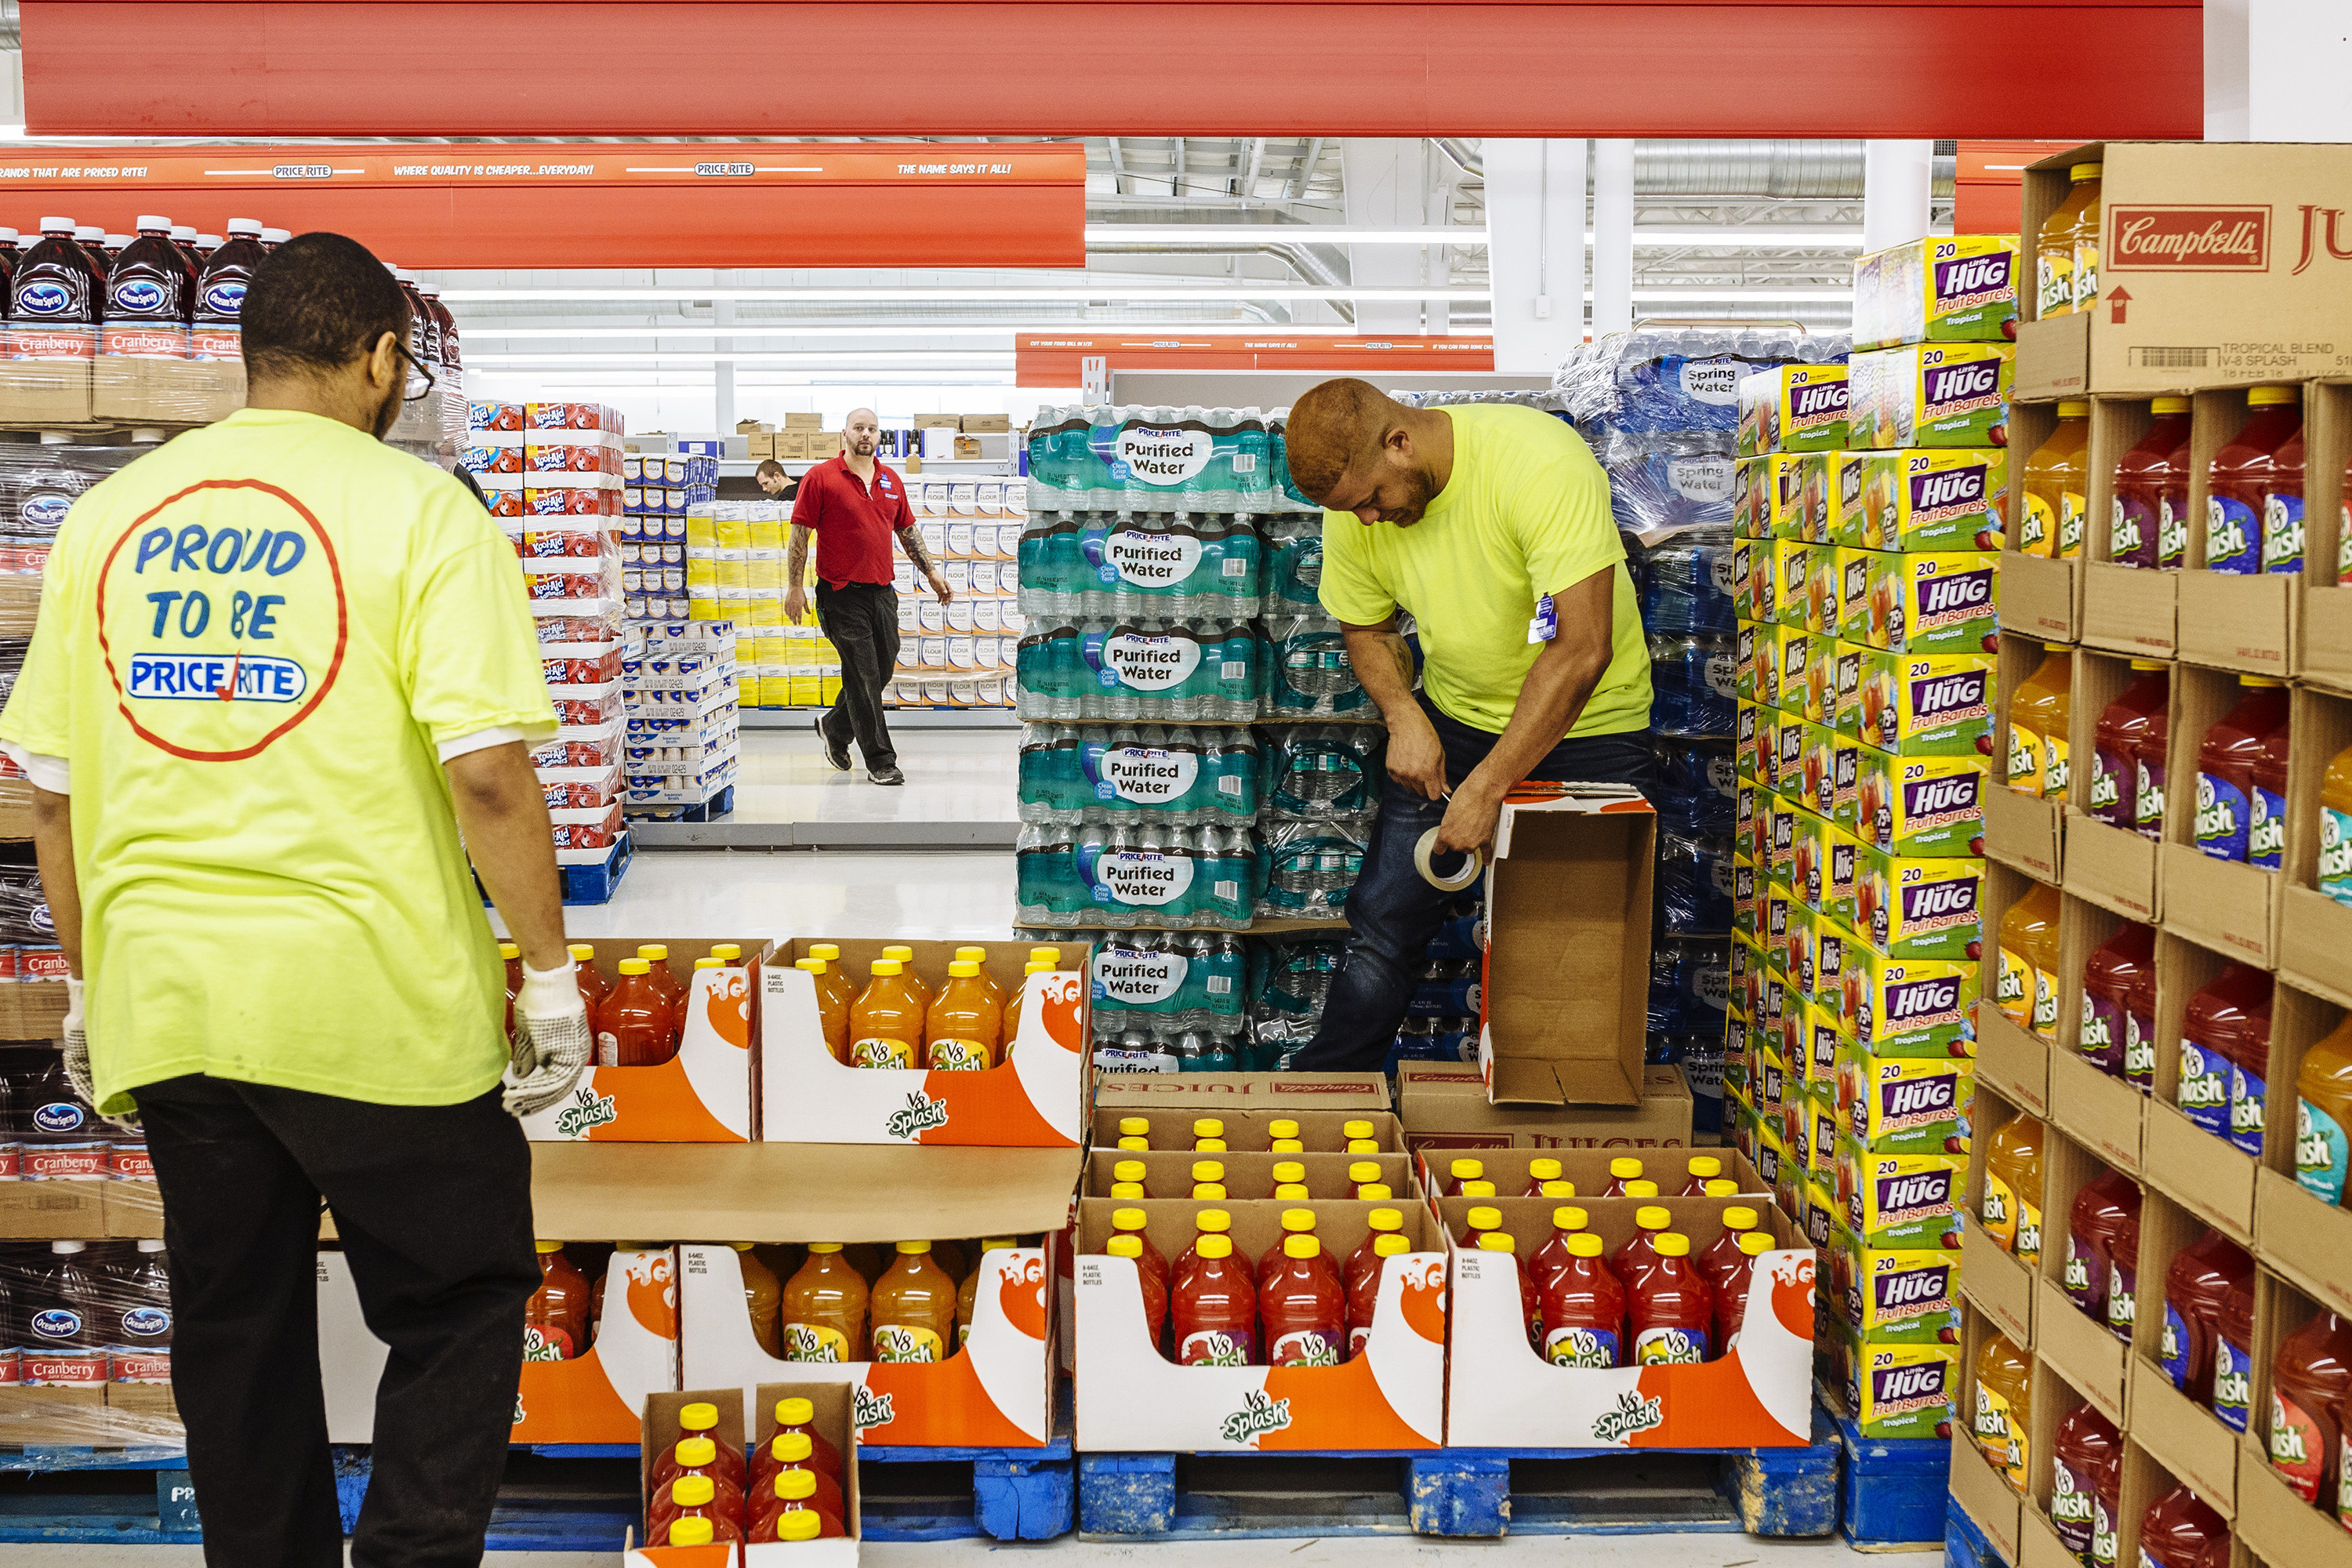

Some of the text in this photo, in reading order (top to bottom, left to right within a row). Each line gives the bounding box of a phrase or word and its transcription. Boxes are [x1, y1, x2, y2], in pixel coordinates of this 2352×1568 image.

[32, 168, 59, 178] THAT
[61, 168, 81, 177] ARE
[84, 168, 118, 177] PRICED
[122, 167, 147, 177] RITE!
[394, 165, 428, 176] WHERE
[431, 165, 471, 176] QUALITY
[474, 165, 484, 175] IS
[898, 164, 1012, 174] THE NAME SAYS IT ALL!
[2120, 216, 2258, 262] Campbell's
[1936, 243, 1955, 258] 20
[1969, 258, 1990, 267] Little
[23, 291, 62, 307] Ocean Spray
[119, 291, 158, 307] Ocean Spray
[1935, 287, 2014, 314] Fruit Barrels
[1946, 313, 1982, 325] Tropical
[20, 337, 84, 355] Cranberry
[112, 336, 176, 353] Cranberry
[2222, 343, 2335, 354] TROPICAL BLEND
[1924, 350, 1943, 365] 20
[2245, 355, 2298, 367] SPLASH
[1688, 368, 1735, 383] Spring
[1958, 365, 1979, 374] Little
[1691, 381, 1733, 393] Water
[1922, 393, 2002, 421] Fruit Barrels
[1138, 427, 1181, 437] PRICE RITE
[1933, 419, 1970, 431] Tropical
[1125, 442, 1193, 458] Purified
[1134, 459, 1185, 475] Water
[1909, 457, 1929, 471] 20
[1677, 466, 1723, 478] Spring
[1944, 471, 1965, 481] Little
[1680, 479, 1721, 490] Water
[1908, 500, 1987, 528] Fruit Barrels
[1127, 531, 1149, 541] PRICE
[1920, 524, 1956, 536] Tropical
[136, 524, 305, 576] PROUD
[1113, 546, 1181, 561] Purified
[1122, 562, 1172, 578] Water
[147, 590, 285, 639] TO BE
[1126, 634, 1148, 644] PRICE
[1113, 649, 1181, 664] Purified
[132, 661, 225, 695] PRICE
[1121, 665, 1171, 681] Water
[1124, 748, 1145, 757] PRICE
[1112, 763, 1178, 779] Purified
[1119, 780, 1170, 795] Water
[1120, 851, 1142, 861] PRICE
[1106, 866, 1174, 882] Purified
[1114, 883, 1166, 898] Water
[1116, 949, 1137, 958] PRICE
[1102, 964, 1168, 979] Purified
[1109, 980, 1160, 994] Water
[870, 1040, 887, 1062] V8
[946, 1041, 964, 1062] V8
[1106, 1082, 1254, 1095] JUICES
[576, 1088, 593, 1106] V8
[907, 1091, 924, 1108] V8
[38, 1111, 77, 1127] Ocean Spray
[561, 1101, 610, 1132] Splash
[892, 1106, 941, 1134] Splash
[34, 1155, 98, 1174] Cranberry
[37, 1318, 74, 1333] Ocean Spray
[1210, 1334, 1230, 1356] V8
[1573, 1334, 1594, 1354] V8
[1874, 1352, 1893, 1366] 20
[33, 1363, 96, 1380] Cranberry
[1905, 1366, 1926, 1375] Little
[1244, 1390, 1265, 1410] V8
[1617, 1391, 1638, 1411] V8
[1872, 1392, 1948, 1417] Fruit Barrels
[1226, 1406, 1283, 1438] Splash
[1598, 1404, 1657, 1438] Splash
[1882, 1415, 1918, 1428] Tropical
